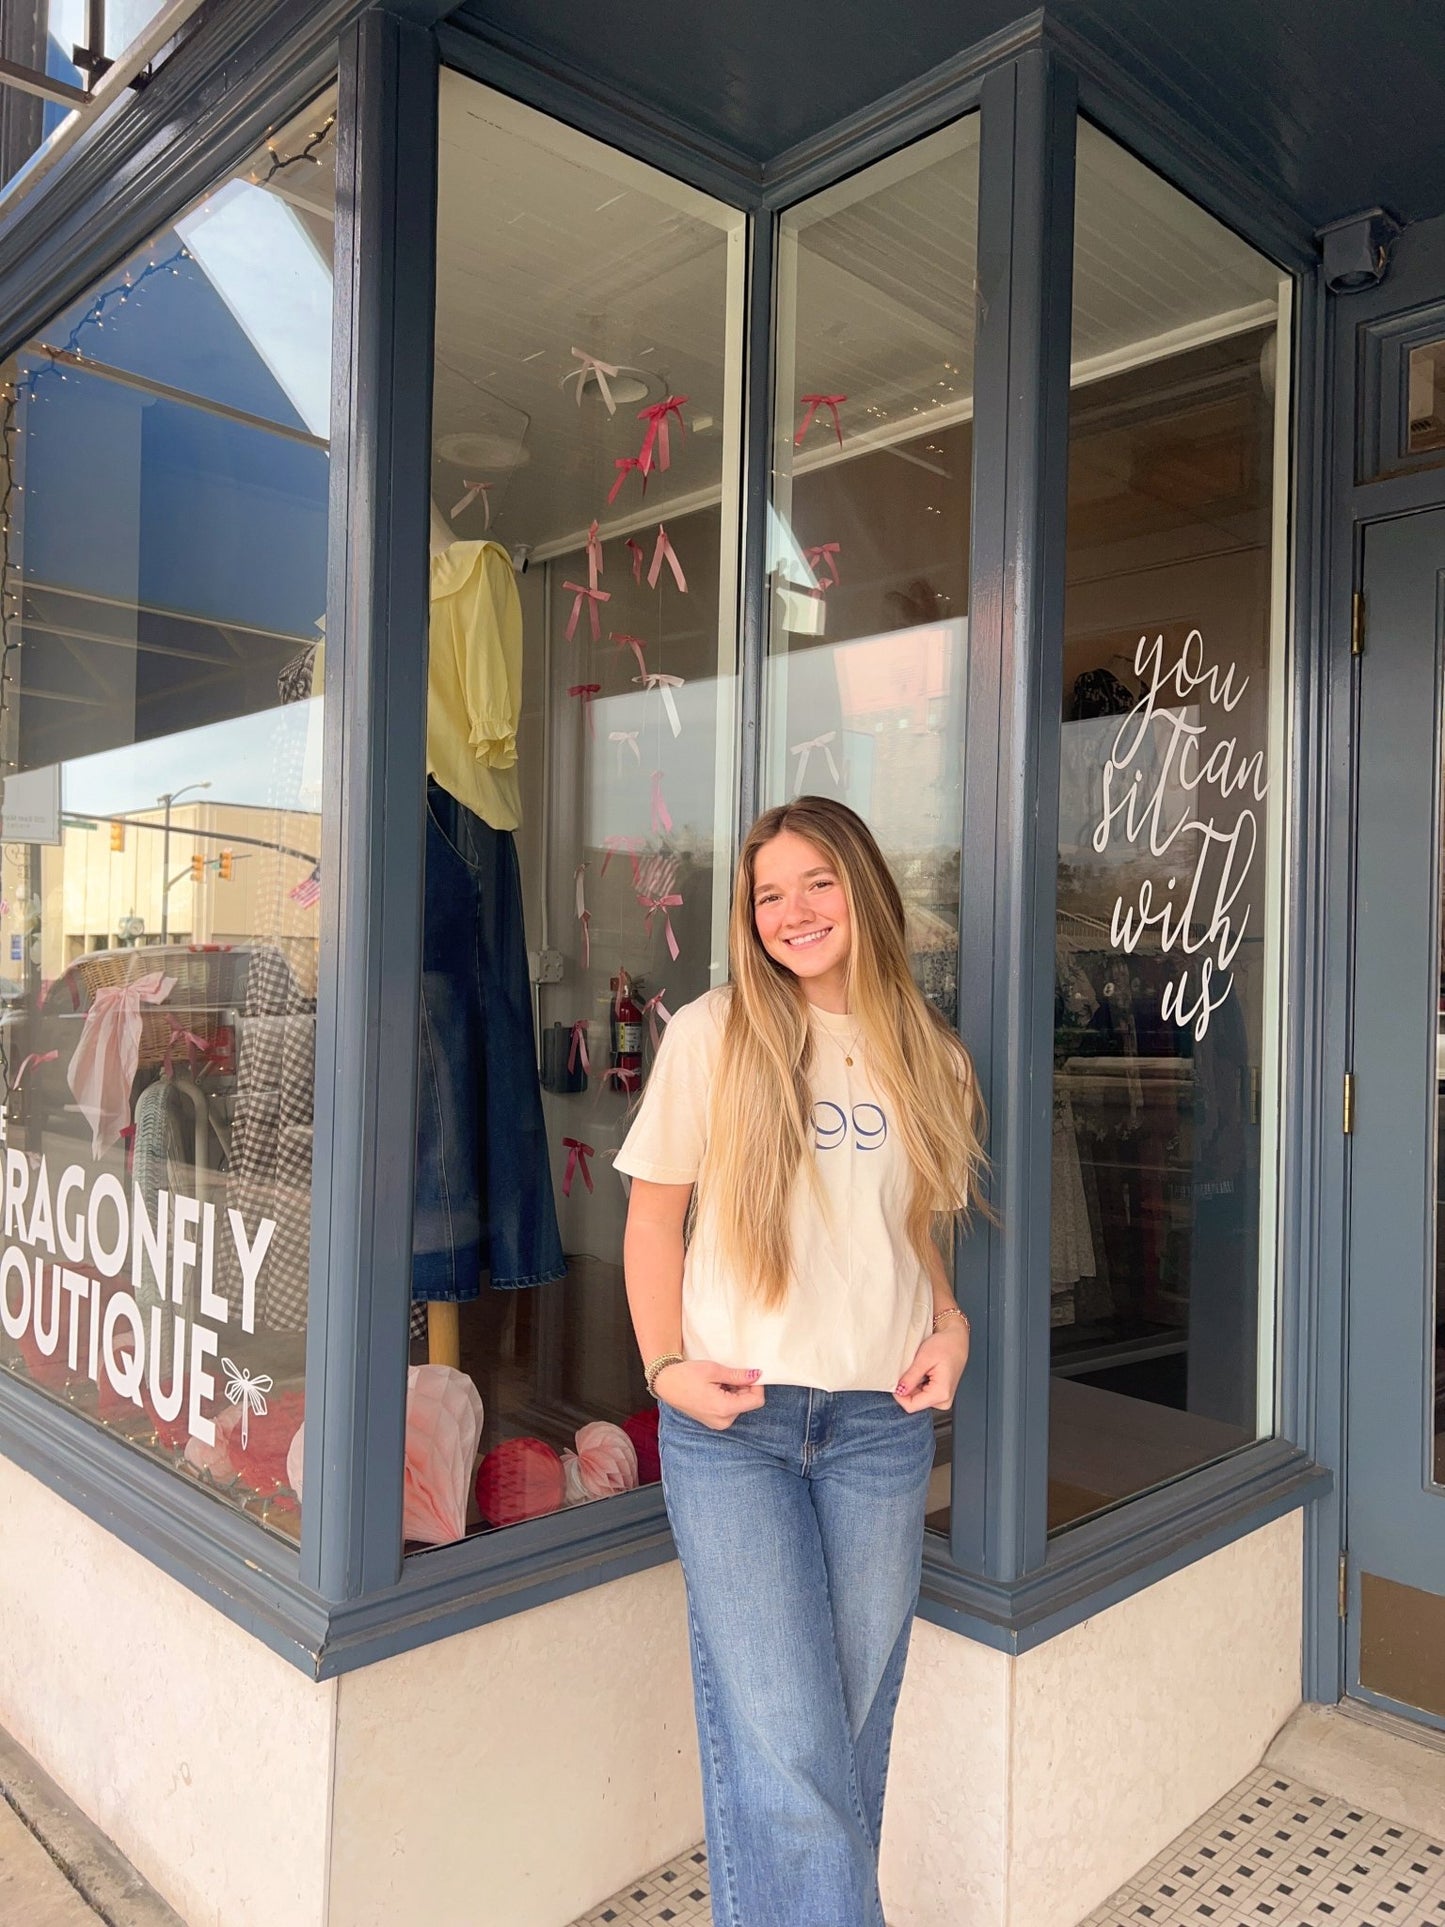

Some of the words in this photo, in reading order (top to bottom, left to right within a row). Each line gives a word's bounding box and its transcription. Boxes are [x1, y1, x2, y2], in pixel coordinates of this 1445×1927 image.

[1112, 629, 1249, 769] you
[1178, 736, 1273, 802] can
[1093, 706, 1206, 858] sit
[1110, 809, 1257, 970] with
[1161, 956, 1235, 1042] us
[810, 1101, 888, 1150] 99
[0, 1148, 277, 1335] RAGONFLY
